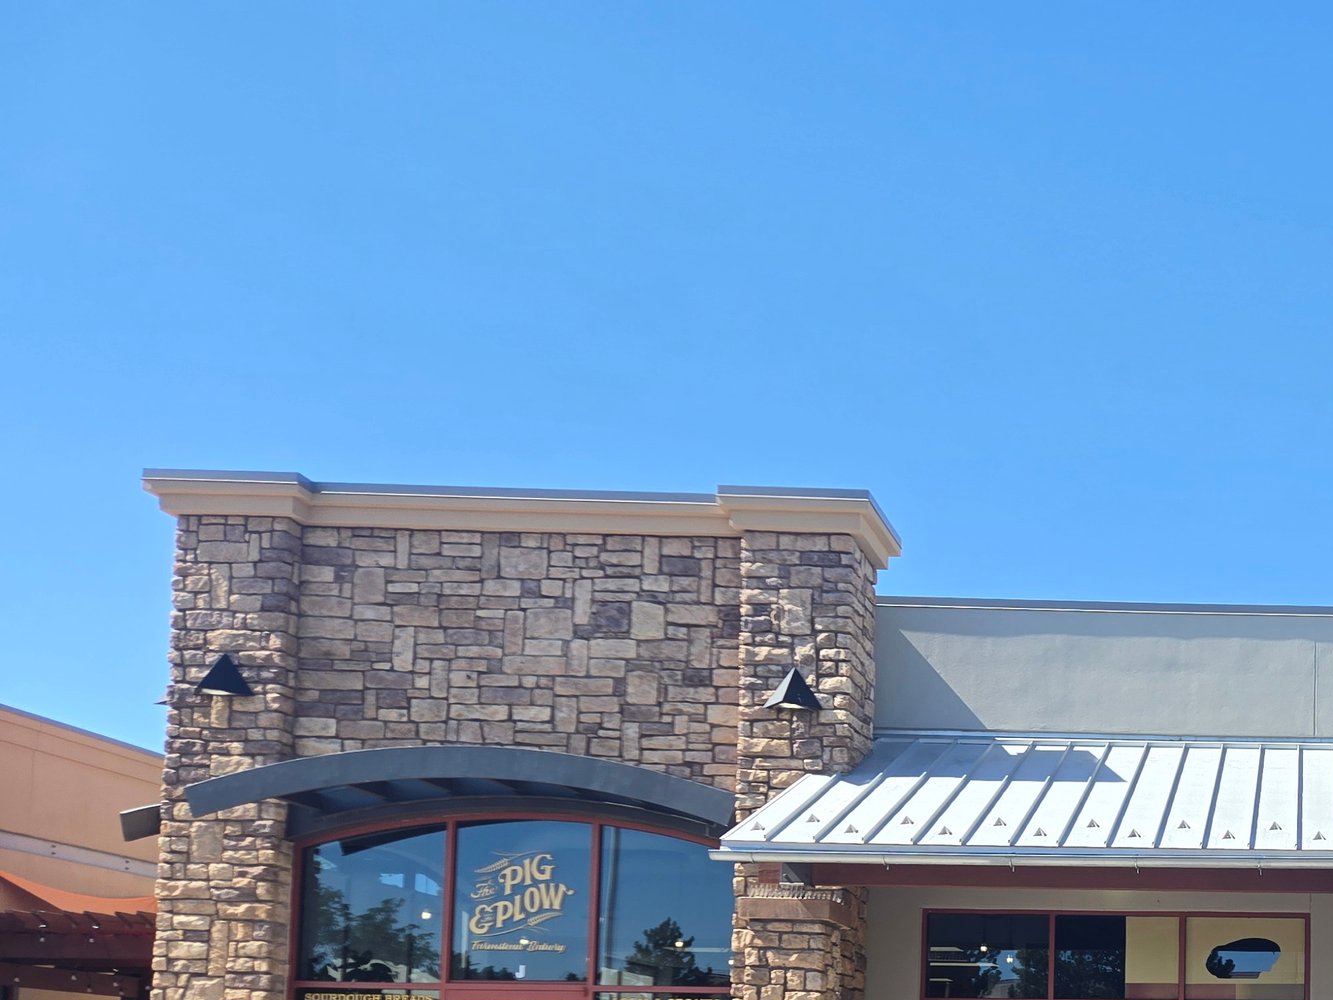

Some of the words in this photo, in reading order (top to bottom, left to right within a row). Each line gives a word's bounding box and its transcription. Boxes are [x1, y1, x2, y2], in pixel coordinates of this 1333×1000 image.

[471, 880, 497, 899] The
[498, 854, 556, 895] PIG
[490, 883, 575, 928] PLOW
[515, 965, 526, 978] J
